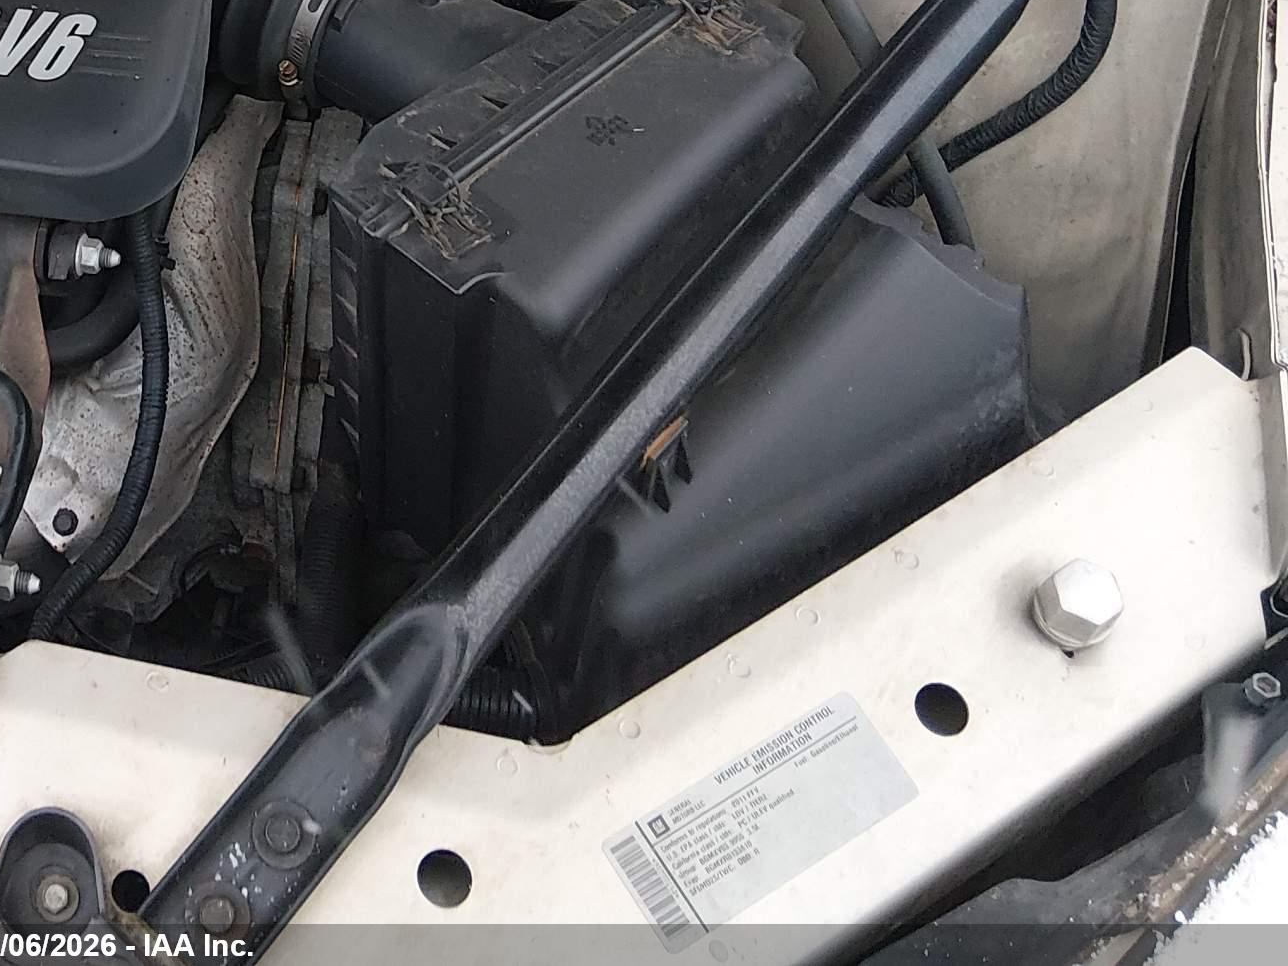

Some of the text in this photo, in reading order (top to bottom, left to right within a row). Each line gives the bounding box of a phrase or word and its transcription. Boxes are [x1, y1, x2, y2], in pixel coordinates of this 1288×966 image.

[713, 704, 833, 785] VEHICLE EMISSION CONTROL
[751, 731, 812, 774] INFORMATION
